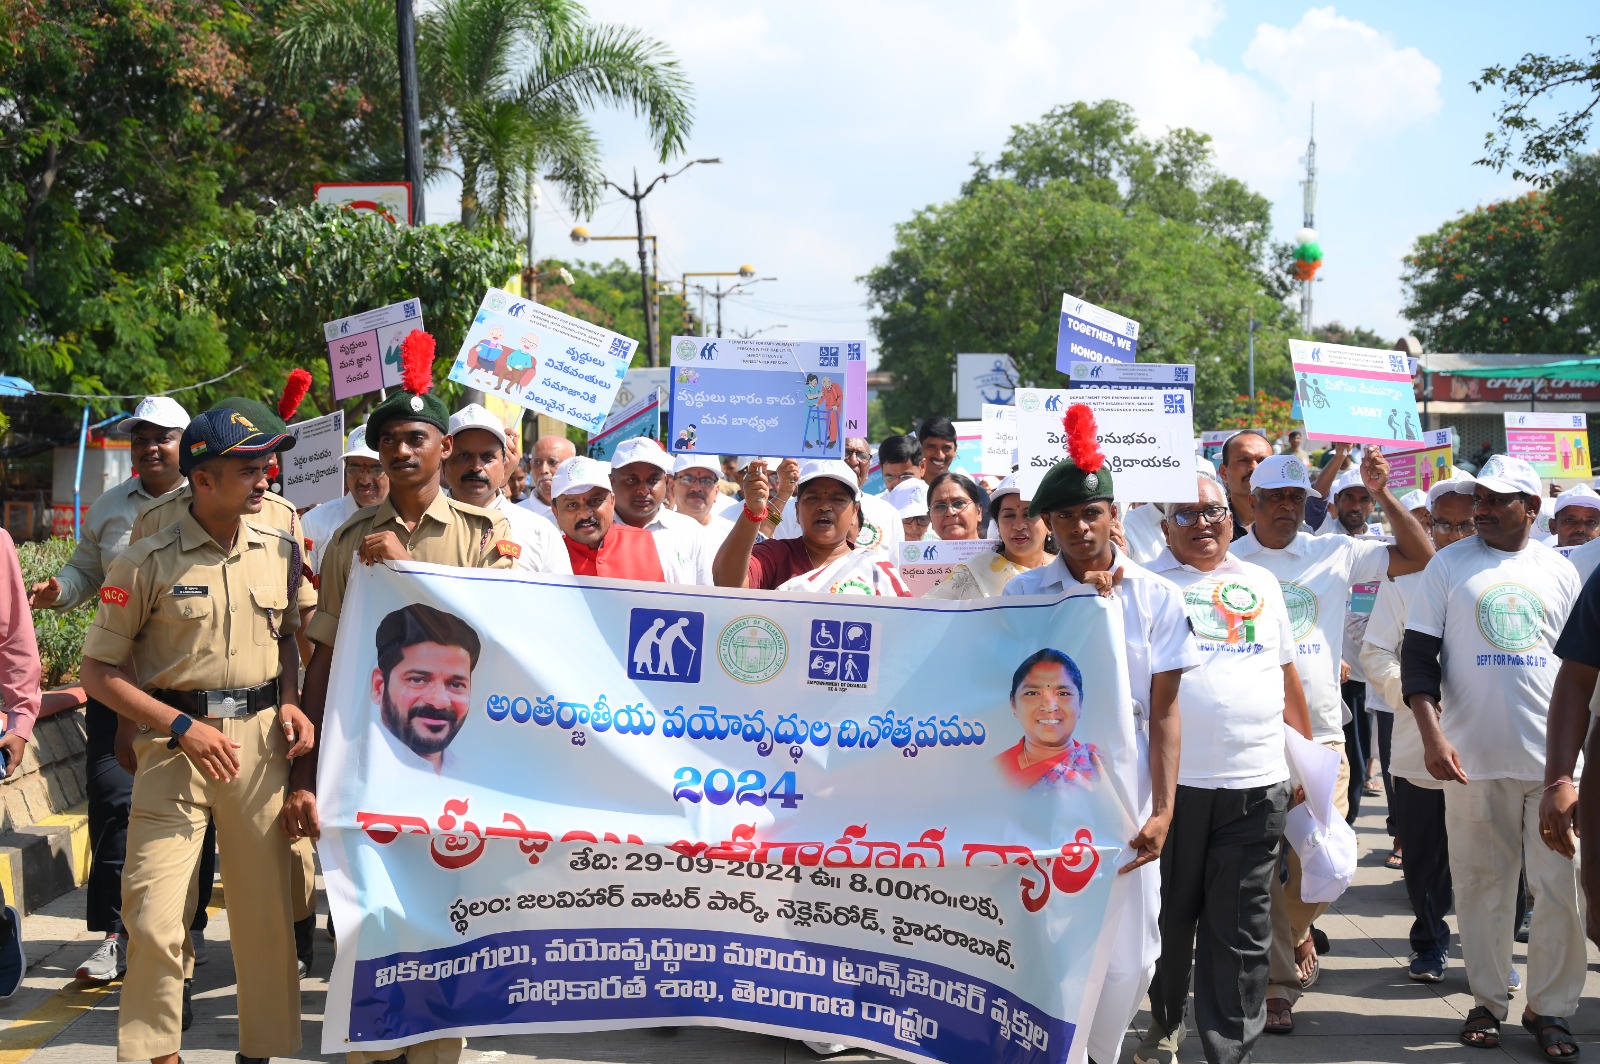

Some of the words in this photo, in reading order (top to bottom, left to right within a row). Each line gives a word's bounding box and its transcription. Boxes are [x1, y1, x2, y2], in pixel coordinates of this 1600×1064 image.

[1067, 317, 1116, 347] TOGETHER,
[1117, 336, 1132, 351] WE
[340, 358, 355, 370] మన
[1070, 342, 1103, 363] HONOR
[346, 370, 370, 384] సంపద
[544, 358, 612, 390] వివేకవంతులు
[541, 378, 598, 404] సమాజానికి
[730, 393, 762, 405] భారం
[766, 395, 796, 406] కాదు
[525, 391, 566, 413] విలువైన
[567, 408, 601, 427] సంపద
[700, 413, 728, 426] మన
[732, 415, 779, 432] బాధ్యత
[500, 543, 518, 555] NCC
[926, 567, 943, 575] మన
[104, 590, 124, 603] NCC
[1480, 587, 1506, 614] GOVERNMENT
[722, 620, 750, 647] GOVERNMENT
[764, 623, 784, 650] TELANGANA
[1200, 643, 1215, 652] FOR
[1238, 644, 1246, 654] SC
[1299, 644, 1306, 655] SC
[1313, 644, 1321, 655] TGP
[1476, 654, 1492, 666] DEPT
[1493, 654, 1506, 666] FOR
[1526, 655, 1534, 667] SC
[486, 694, 656, 746] అంతర్జాతీయ
[662, 706, 832, 764] వయోవృద్ధుల
[836, 710, 986, 758] దినోత్సవము
[672, 766, 804, 809] 2024
[624, 853, 802, 884] 29-09-2024
[450, 897, 512, 936] స్థలం:
[517, 885, 625, 911] జలవిహార్
[630, 887, 701, 910] వాటర్
[892, 915, 1015, 970] హైదరాబాద్.
[374, 942, 537, 988] వికలాంగులు,
[545, 937, 716, 974] వయోవృద్ధులు
[723, 942, 826, 977] మరియు
[990, 997, 1050, 1052] వ్యక్తుల
[508, 976, 647, 1006] సాధికారత
[654, 976, 724, 1003] శాఖ,
[732, 979, 856, 1019] తెలంగాణ
[860, 1000, 940, 1046] రాష్ట్రం
